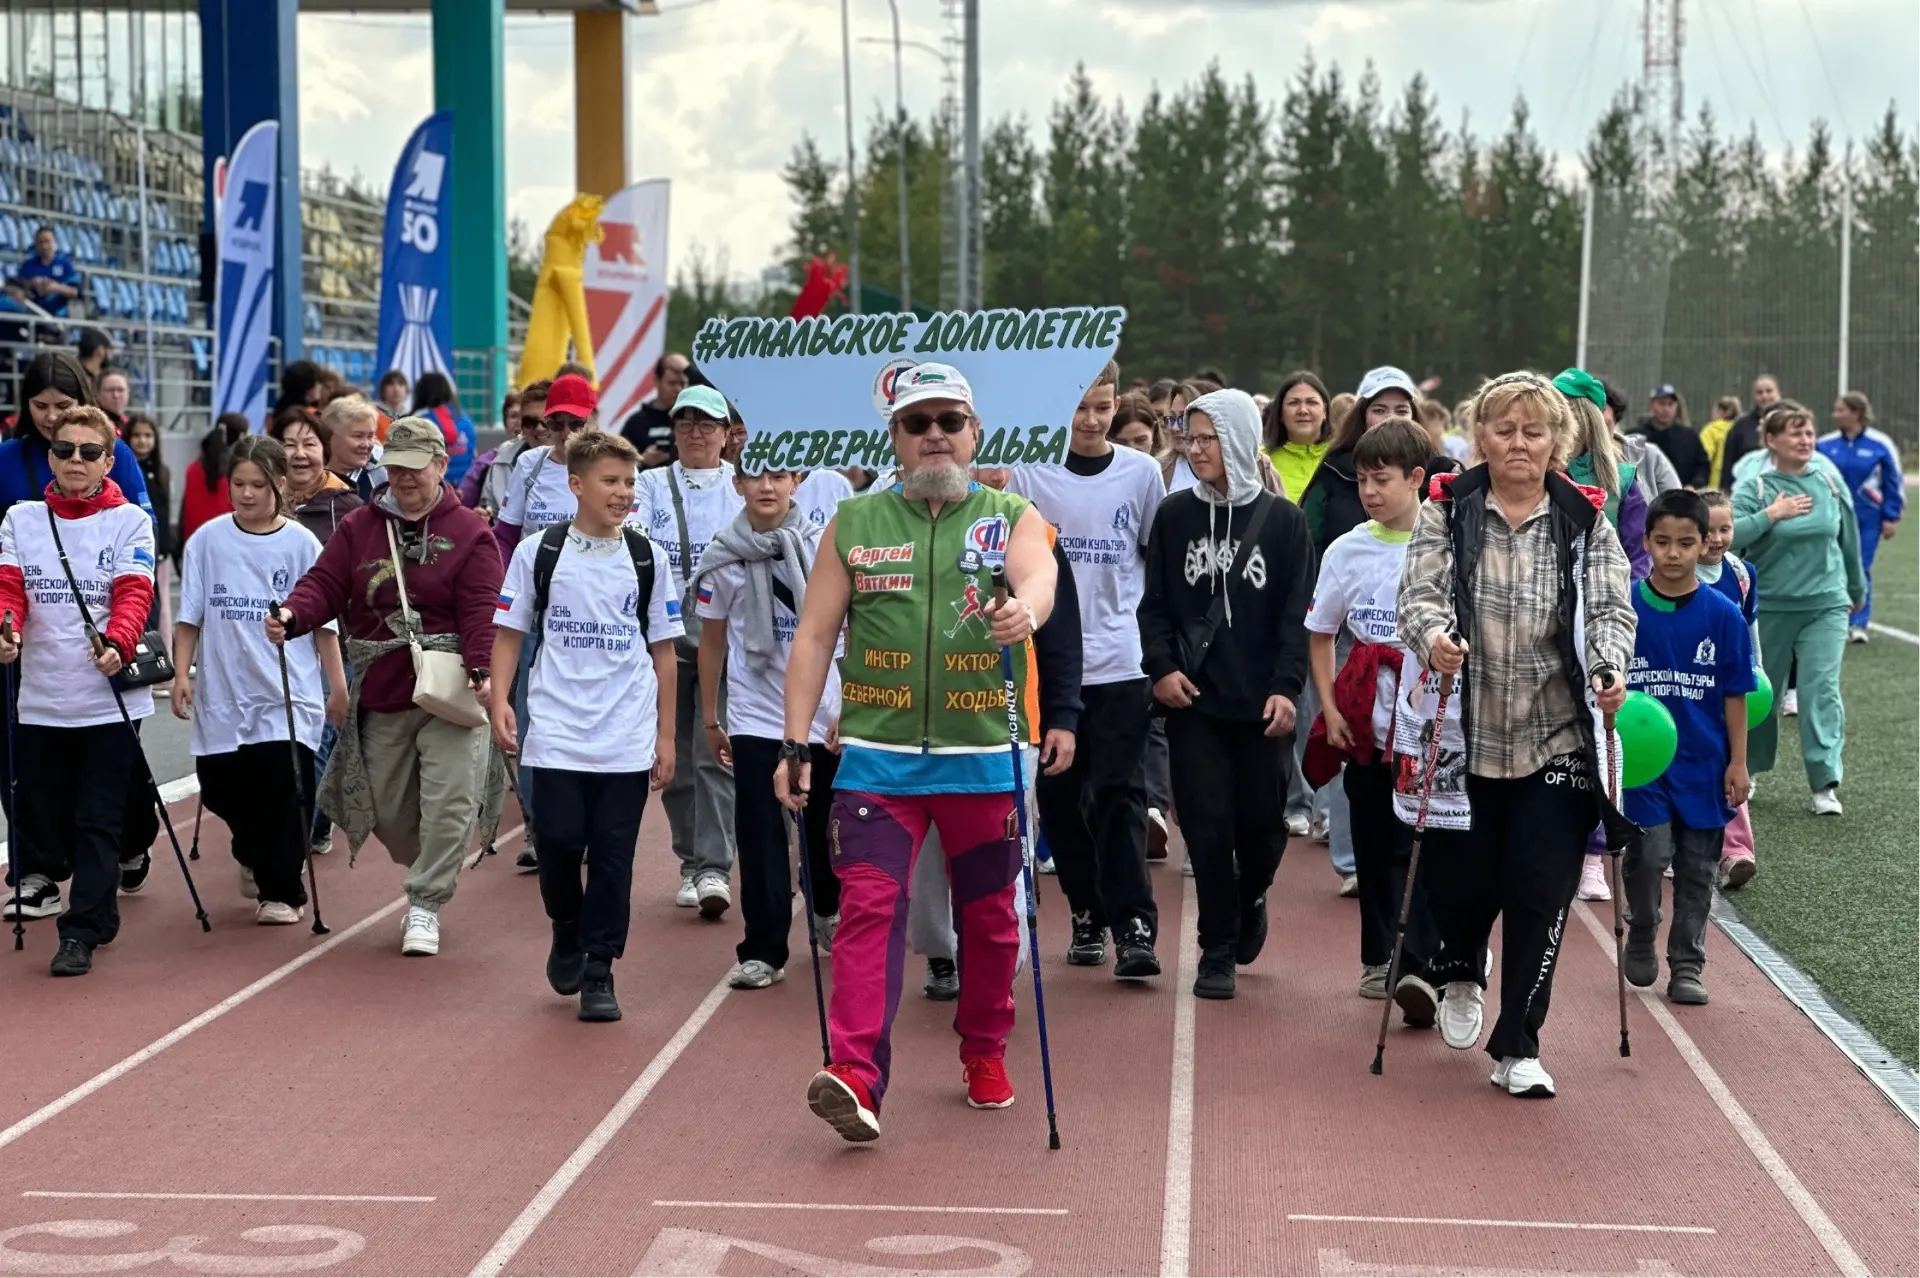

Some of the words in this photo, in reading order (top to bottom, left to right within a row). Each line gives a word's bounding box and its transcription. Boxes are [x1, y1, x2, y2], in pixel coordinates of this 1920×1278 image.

[695, 314, 914, 363] #ЯМАЛЬСКОЕ
[914, 309, 1123, 353] ДОЛГОЛЕТИЕ
[849, 543, 914, 567] Сергей
[856, 573, 912, 592] Вяткин
[563, 635, 570, 648] И
[571, 636, 605, 650] СПОРТА
[607, 638, 615, 651] В
[842, 681, 912, 710] СЕВЕРНОЙ
[1005, 680, 1018, 744] RAINBOW
[1544, 771, 1567, 785] OF
